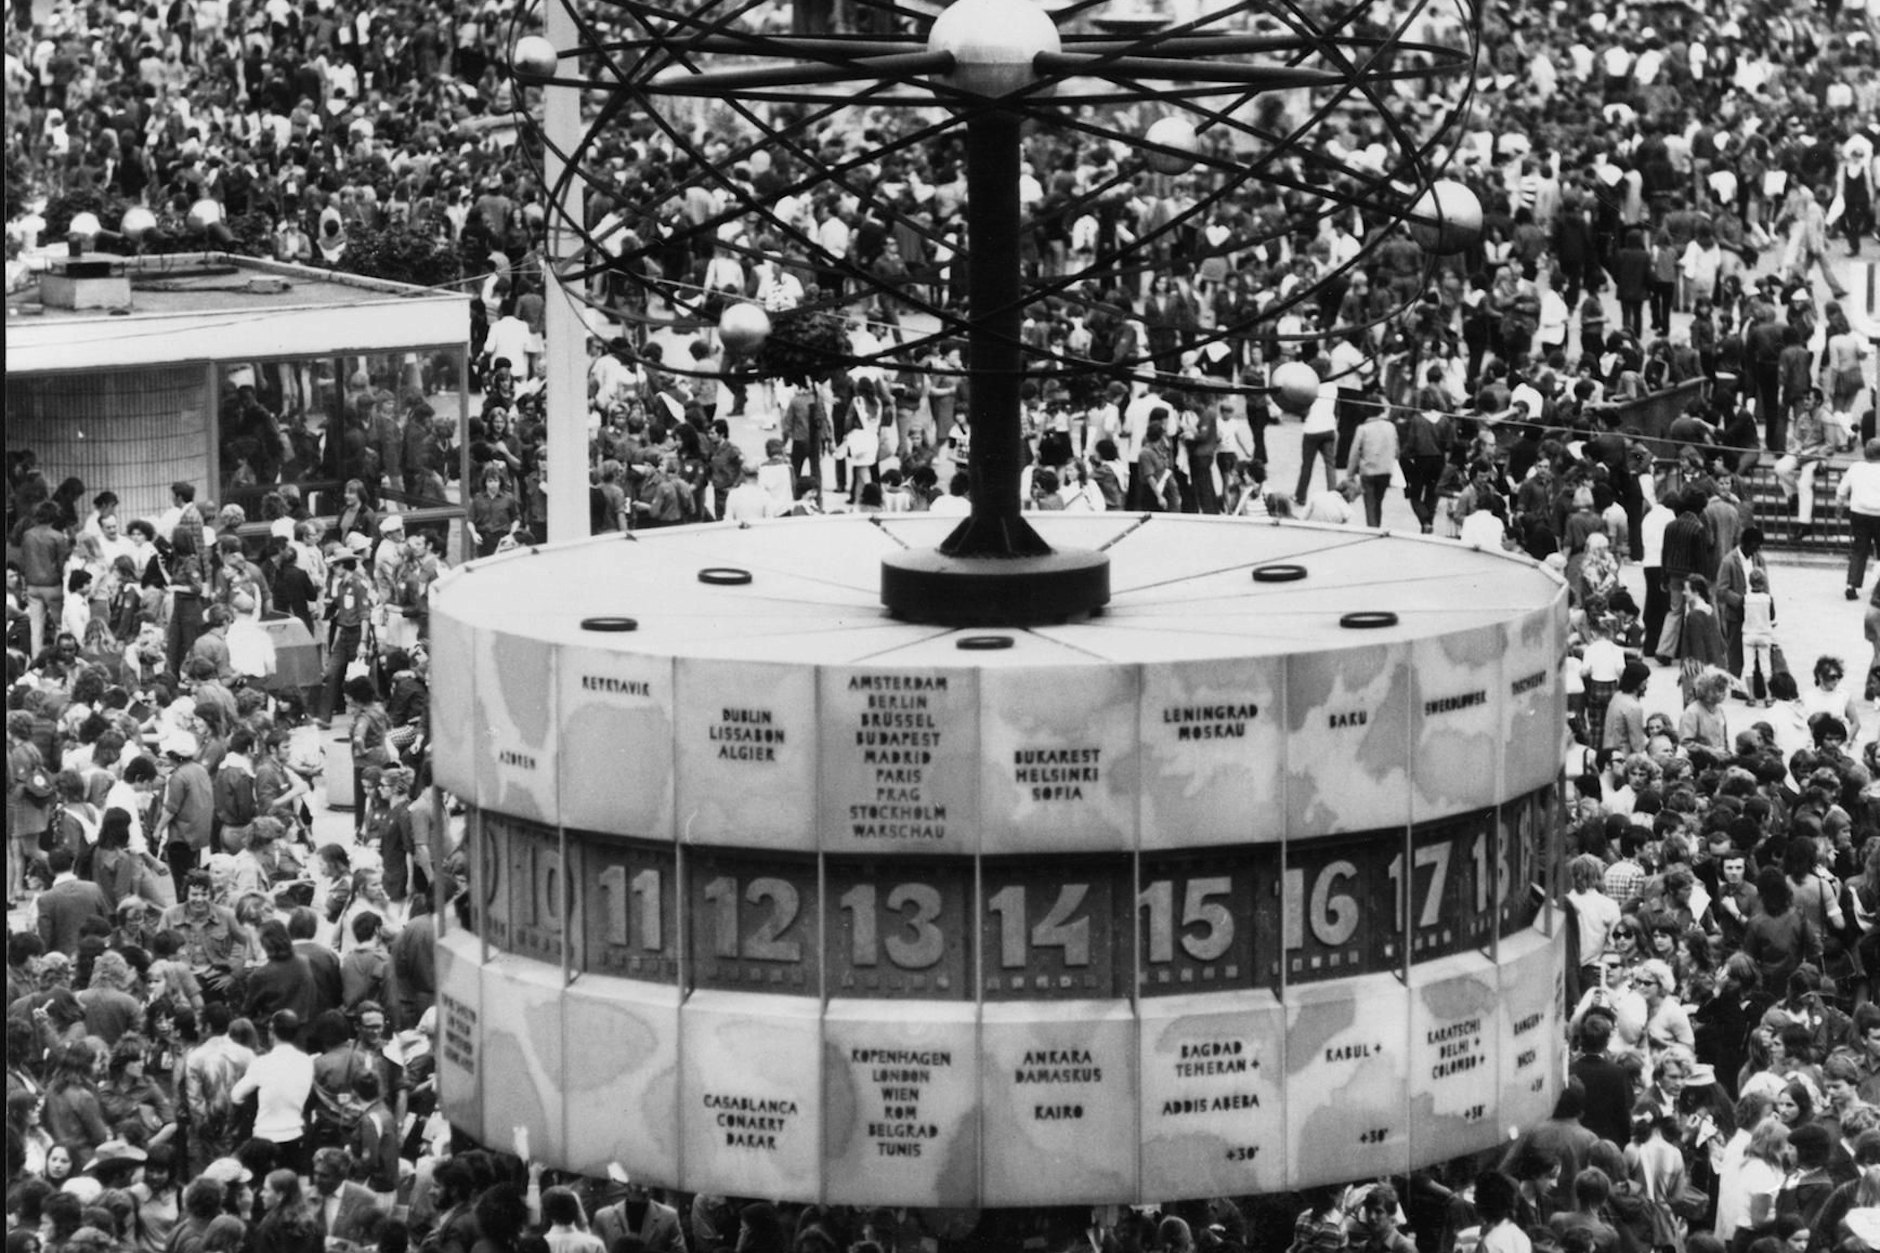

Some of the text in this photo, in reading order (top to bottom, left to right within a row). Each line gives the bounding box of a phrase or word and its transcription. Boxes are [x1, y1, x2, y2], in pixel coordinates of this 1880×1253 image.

[848, 675, 949, 691] AMSTERDAM
[867, 694, 929, 709] BERLIN
[721, 707, 773, 724] DUBLIN
[861, 712, 936, 728] BRÜSSEL
[1162, 704, 1259, 723] LENINGRAD
[1328, 711, 1368, 729] BAKU
[708, 725, 785, 744] LISSABON
[855, 731, 941, 747] BUDAPEST
[1177, 723, 1246, 741] MOSKAU
[717, 745, 775, 762] ALGIER
[863, 751, 931, 765] MADRID
[1013, 749, 1101, 765] BUKAREST
[875, 768, 922, 784] PARIS
[1014, 767, 1099, 783] HELSINKI
[876, 787, 921, 802] PRAG
[1031, 786, 1084, 801] SOFIA
[849, 805, 947, 821] STOCKHOLM
[852, 823, 945, 839] WARSCHAU
[1387, 840, 1453, 933] 17
[600, 865, 660, 951] 11
[704, 876, 801, 962] 12
[839, 882, 945, 969] 13
[988, 883, 1090, 969] 14
[1138, 876, 1235, 962] 15
[851, 1049, 952, 1066] KOPENHAGEN
[1023, 1050, 1092, 1066] ANKARA
[1181, 1041, 1242, 1059] BAGDAD
[1326, 1044, 1371, 1063] KABUL
[1176, 1059, 1247, 1078] TEHERAN
[1432, 1054, 1477, 1080] COLOMBO
[872, 1069, 931, 1083] LONDON
[1014, 1068, 1103, 1084] DAMASKUS
[881, 1087, 920, 1101] WIEN
[703, 1094, 798, 1115] CASABLANCA
[884, 1105, 918, 1120] ROM
[1033, 1104, 1084, 1121] KAIRO
[1162, 1094, 1261, 1116] ADDIS ABEBA
[716, 1112, 786, 1132] CONAKRY
[868, 1123, 939, 1139] BELGRAD
[877, 1142, 922, 1158] TUNIS
